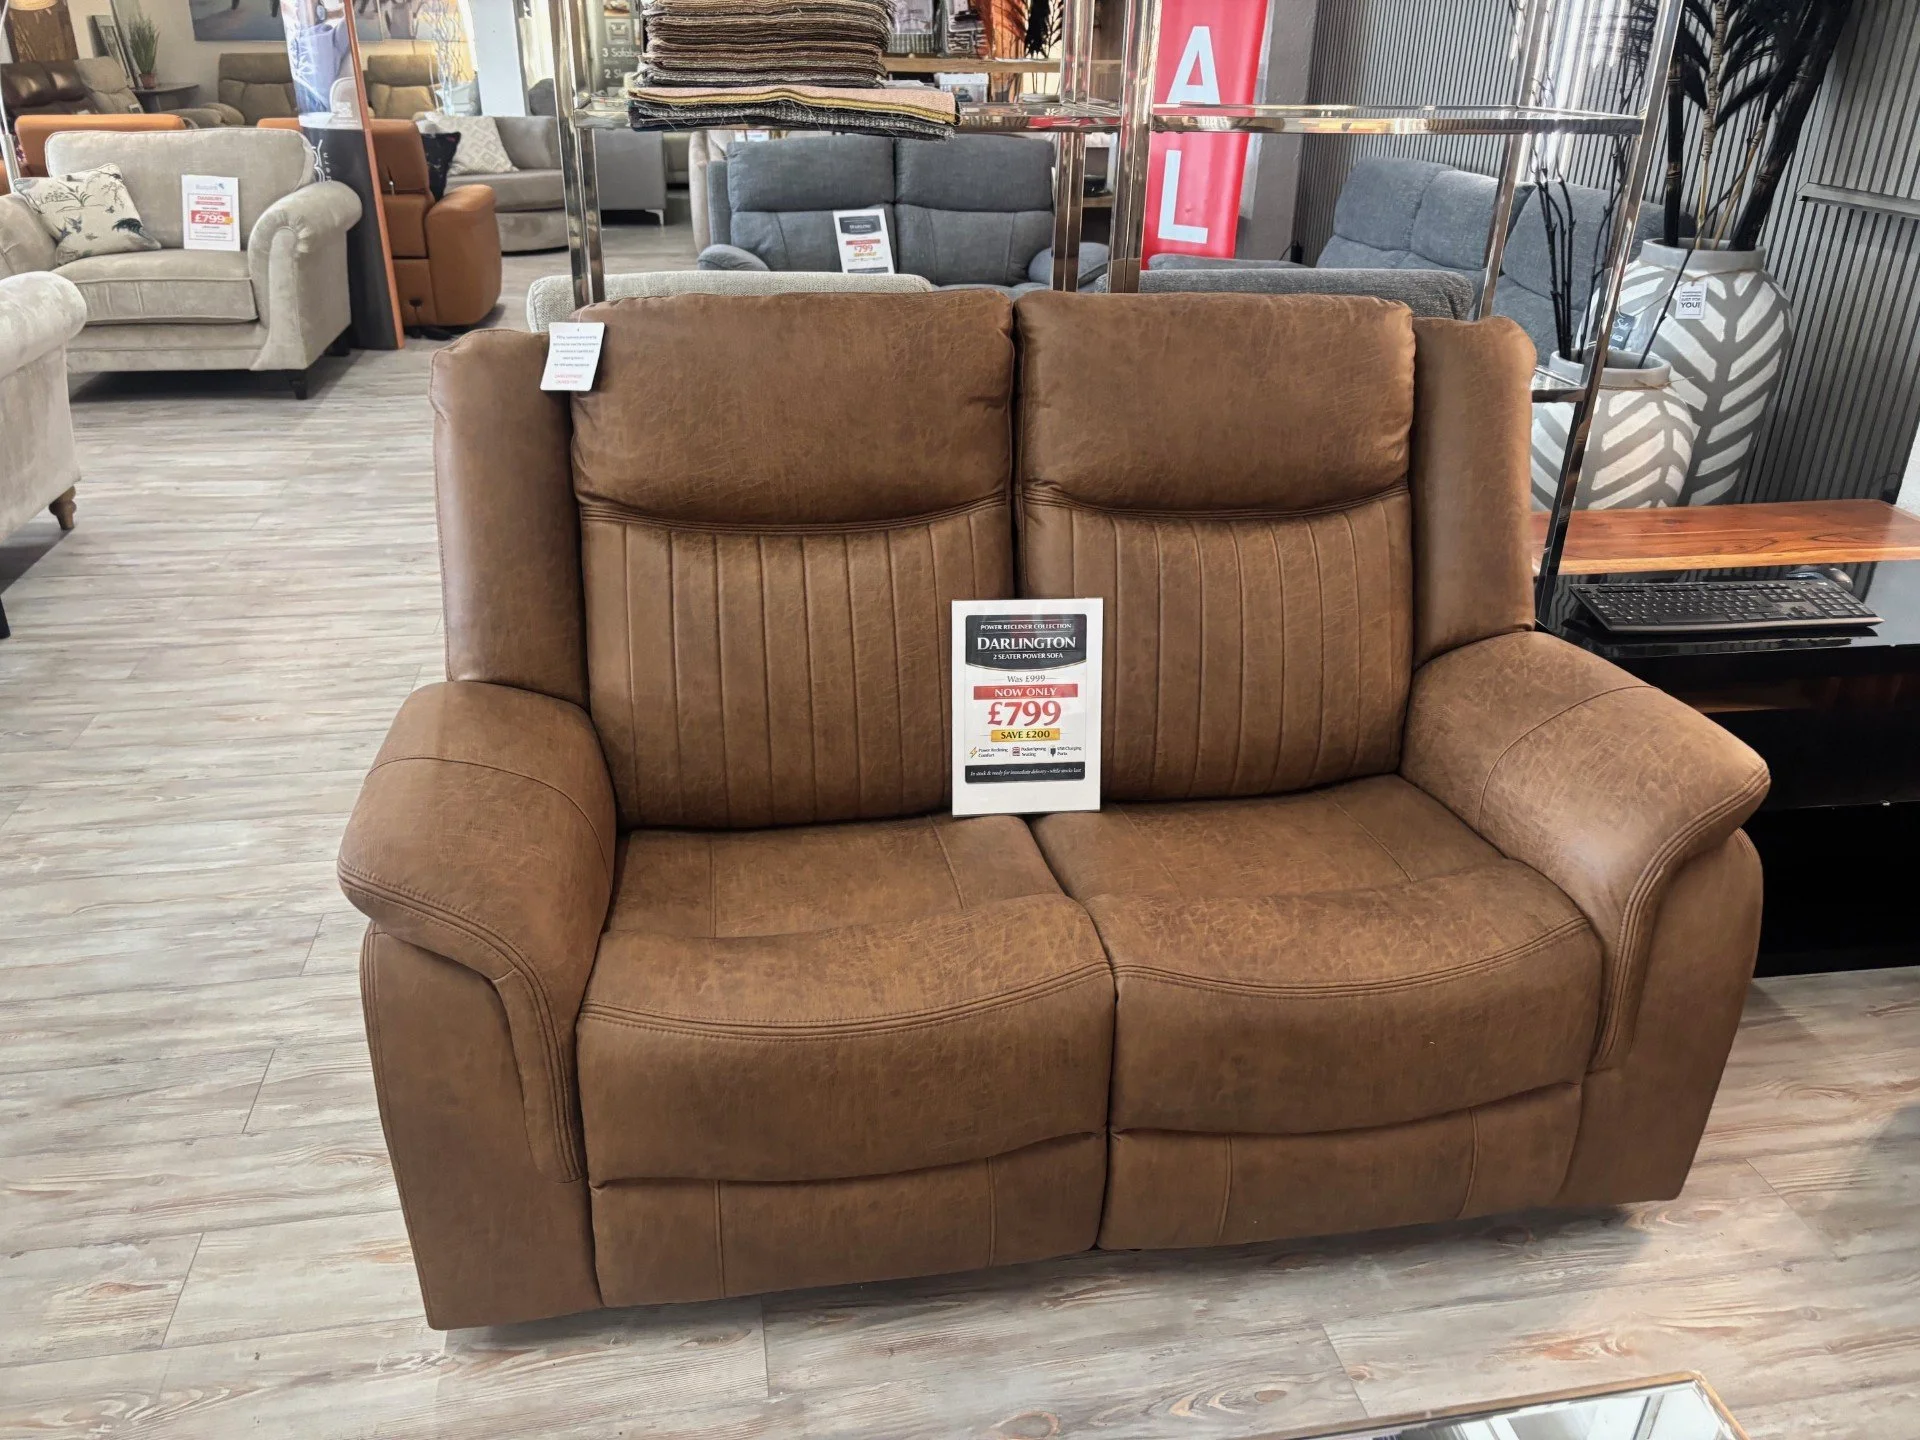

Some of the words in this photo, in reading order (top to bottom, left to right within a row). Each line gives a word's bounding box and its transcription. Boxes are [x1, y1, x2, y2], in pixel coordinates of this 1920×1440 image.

[602, 48, 609, 57] 3
[604, 68, 612, 79] 2
[194, 213, 225, 224] £799
[977, 636, 1076, 650] DARLINGTON
[1006, 675, 1023, 683] Was
[1025, 674, 1046, 683] £999
[994, 688, 1023, 697] NOW
[1026, 687, 1058, 697] ONLY
[987, 700, 1062, 727] £799
[1000, 731, 1024, 740] SAVE
[1026, 730, 1051, 739] £200
